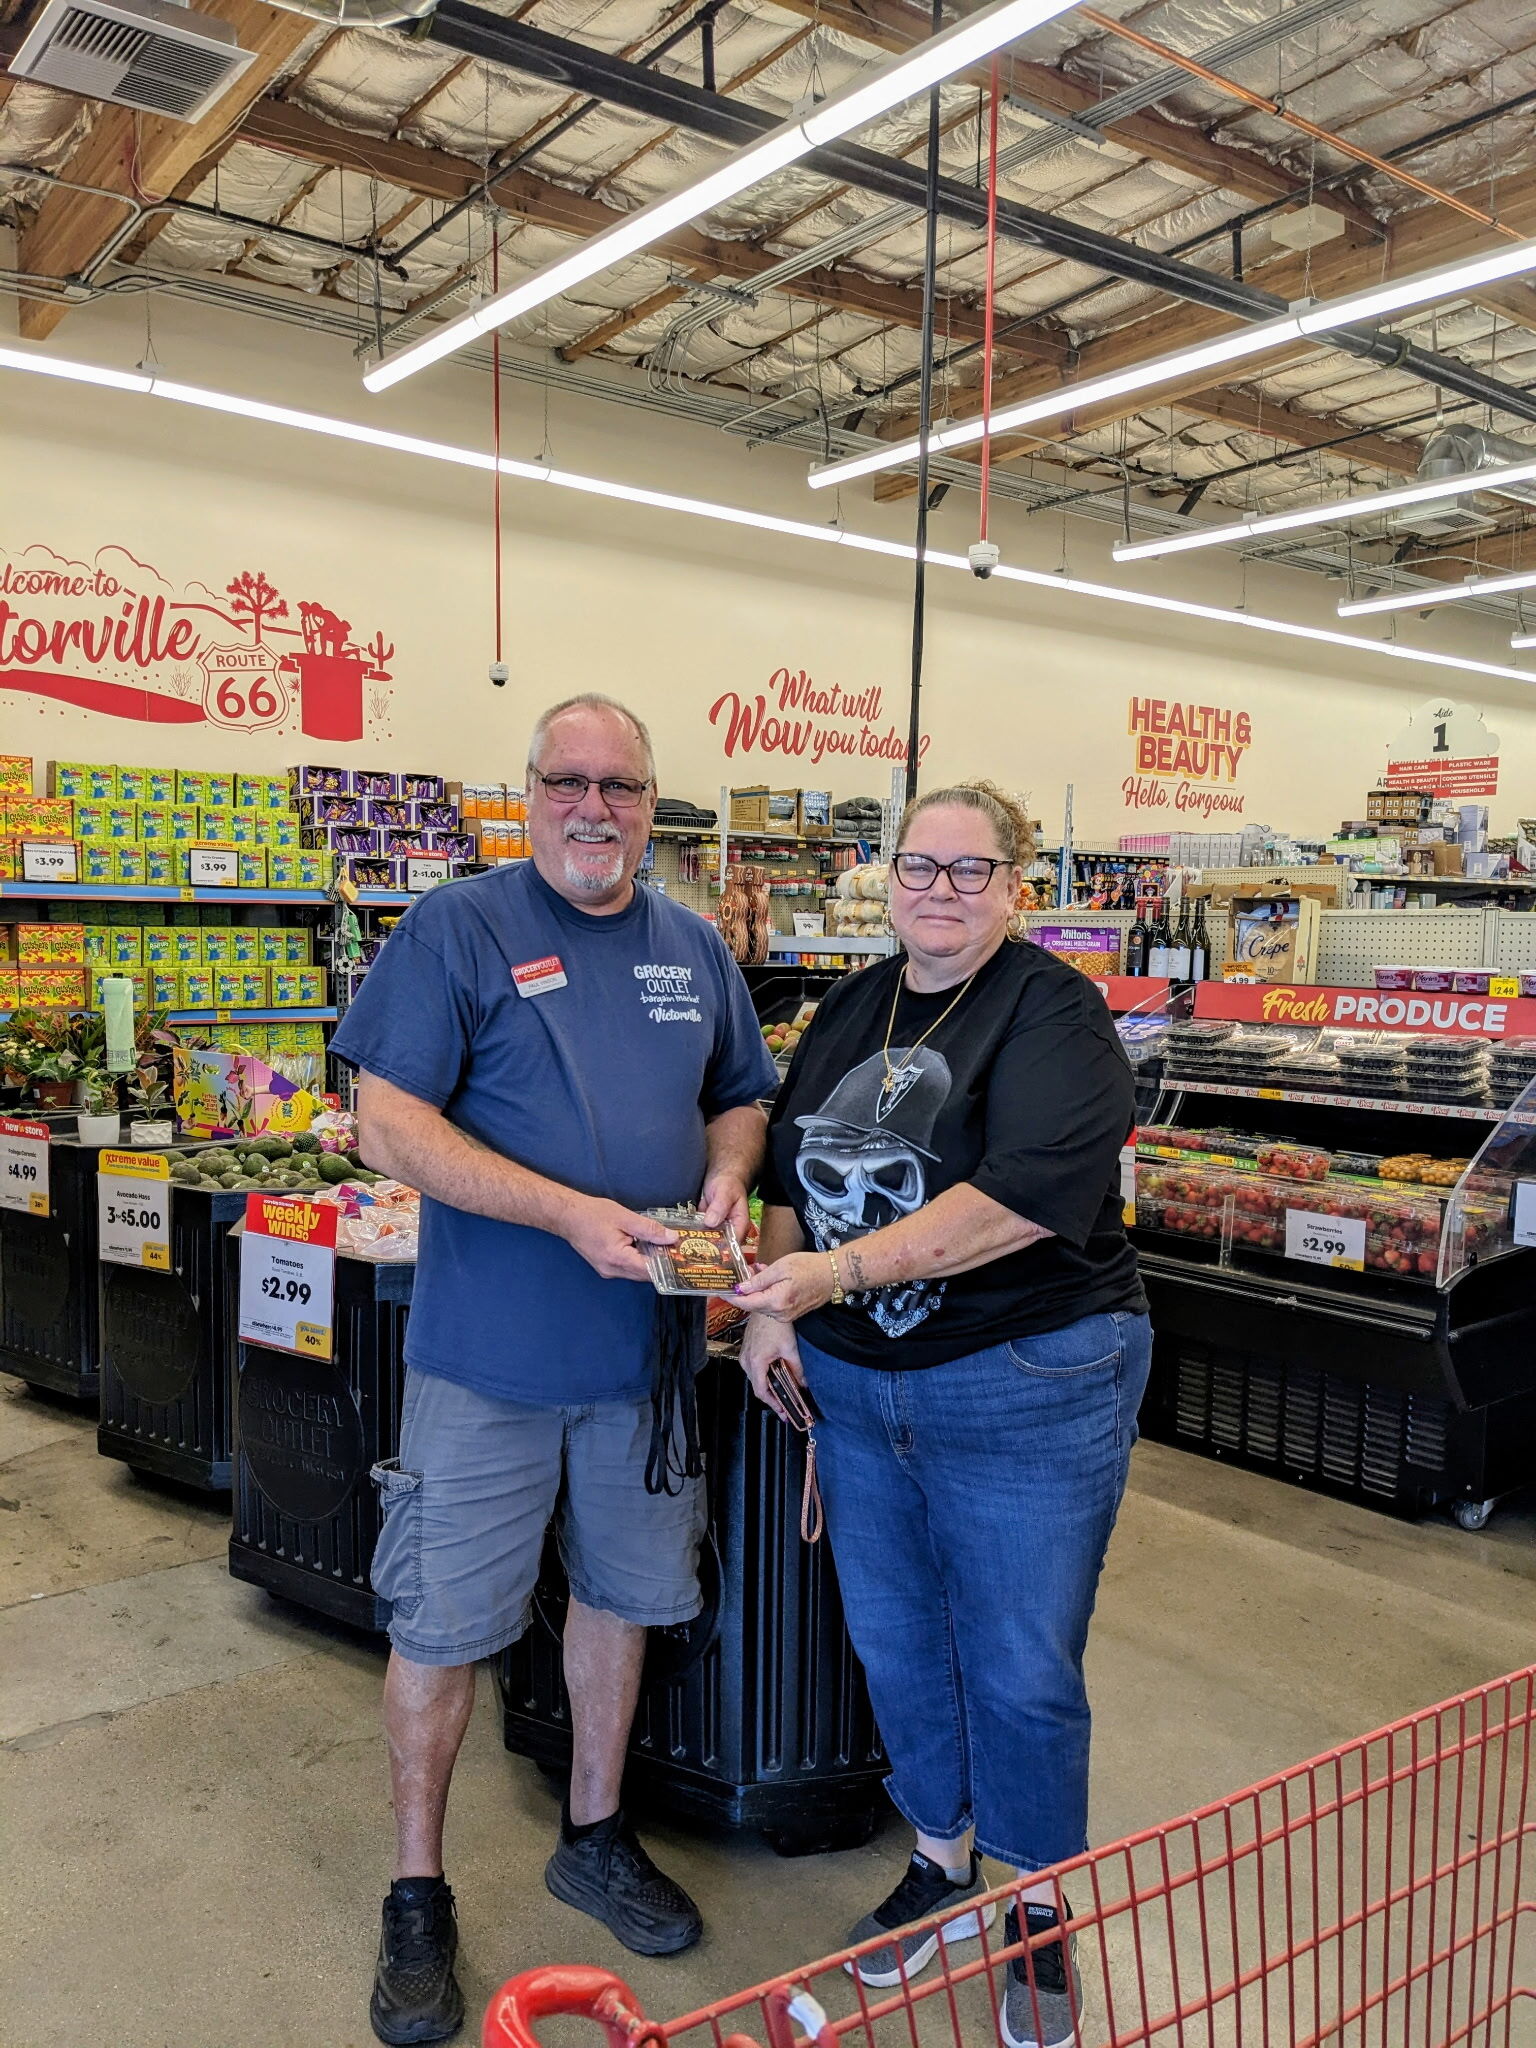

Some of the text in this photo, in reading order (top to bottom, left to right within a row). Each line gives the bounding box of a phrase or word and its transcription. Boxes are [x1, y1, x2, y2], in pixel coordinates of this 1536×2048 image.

[0, 563, 122, 597] lcome to
[216, 653, 267, 668] ROUTE
[217, 677, 277, 718] 66
[769, 668, 882, 722] What will
[709, 692, 813, 758] Wow
[810, 730, 858, 764] you
[1128, 696, 1252, 749] HEALTH &
[1433, 722, 1449, 752] 1
[1136, 735, 1243, 782] BEAUTY
[1122, 776, 1244, 819] Hello, Gorgeous
[35, 857, 64, 866] $3.99
[201, 863, 227, 872] $3.99
[1061, 929, 1092, 940] Milton's
[22, 942, 49, 951] Gushers
[54, 942, 81, 951] Gushers
[1073, 940, 1101, 948] MULTI-GRAIN
[633, 964, 692, 981] GROCERY
[24, 986, 50, 996] Gushers
[56, 986, 82, 996] Gushers
[646, 979, 689, 994] OUTLET
[640, 991, 700, 1007] bargain market
[649, 1007, 702, 1024] Victorville
[1262, 988, 1508, 1032] Fresh PRODUCE
[5, 1122, 19, 1131] new
[25, 1126, 43, 1136] store
[137, 1156, 160, 1168] value
[8, 1164, 37, 1181] $4.99
[116, 1190, 151, 1201] Avocado Hass
[262, 1203, 321, 1231] weekly
[689, 1230, 720, 1238] PASS
[1306, 1223, 1343, 1235] Strawberries
[1302, 1237, 1346, 1256] $2.99
[150, 1252, 162, 1261] 44%
[271, 1255, 304, 1270] Tomatoes
[261, 1276, 312, 1306] $2.99
[305, 1335, 323, 1347] 40%
